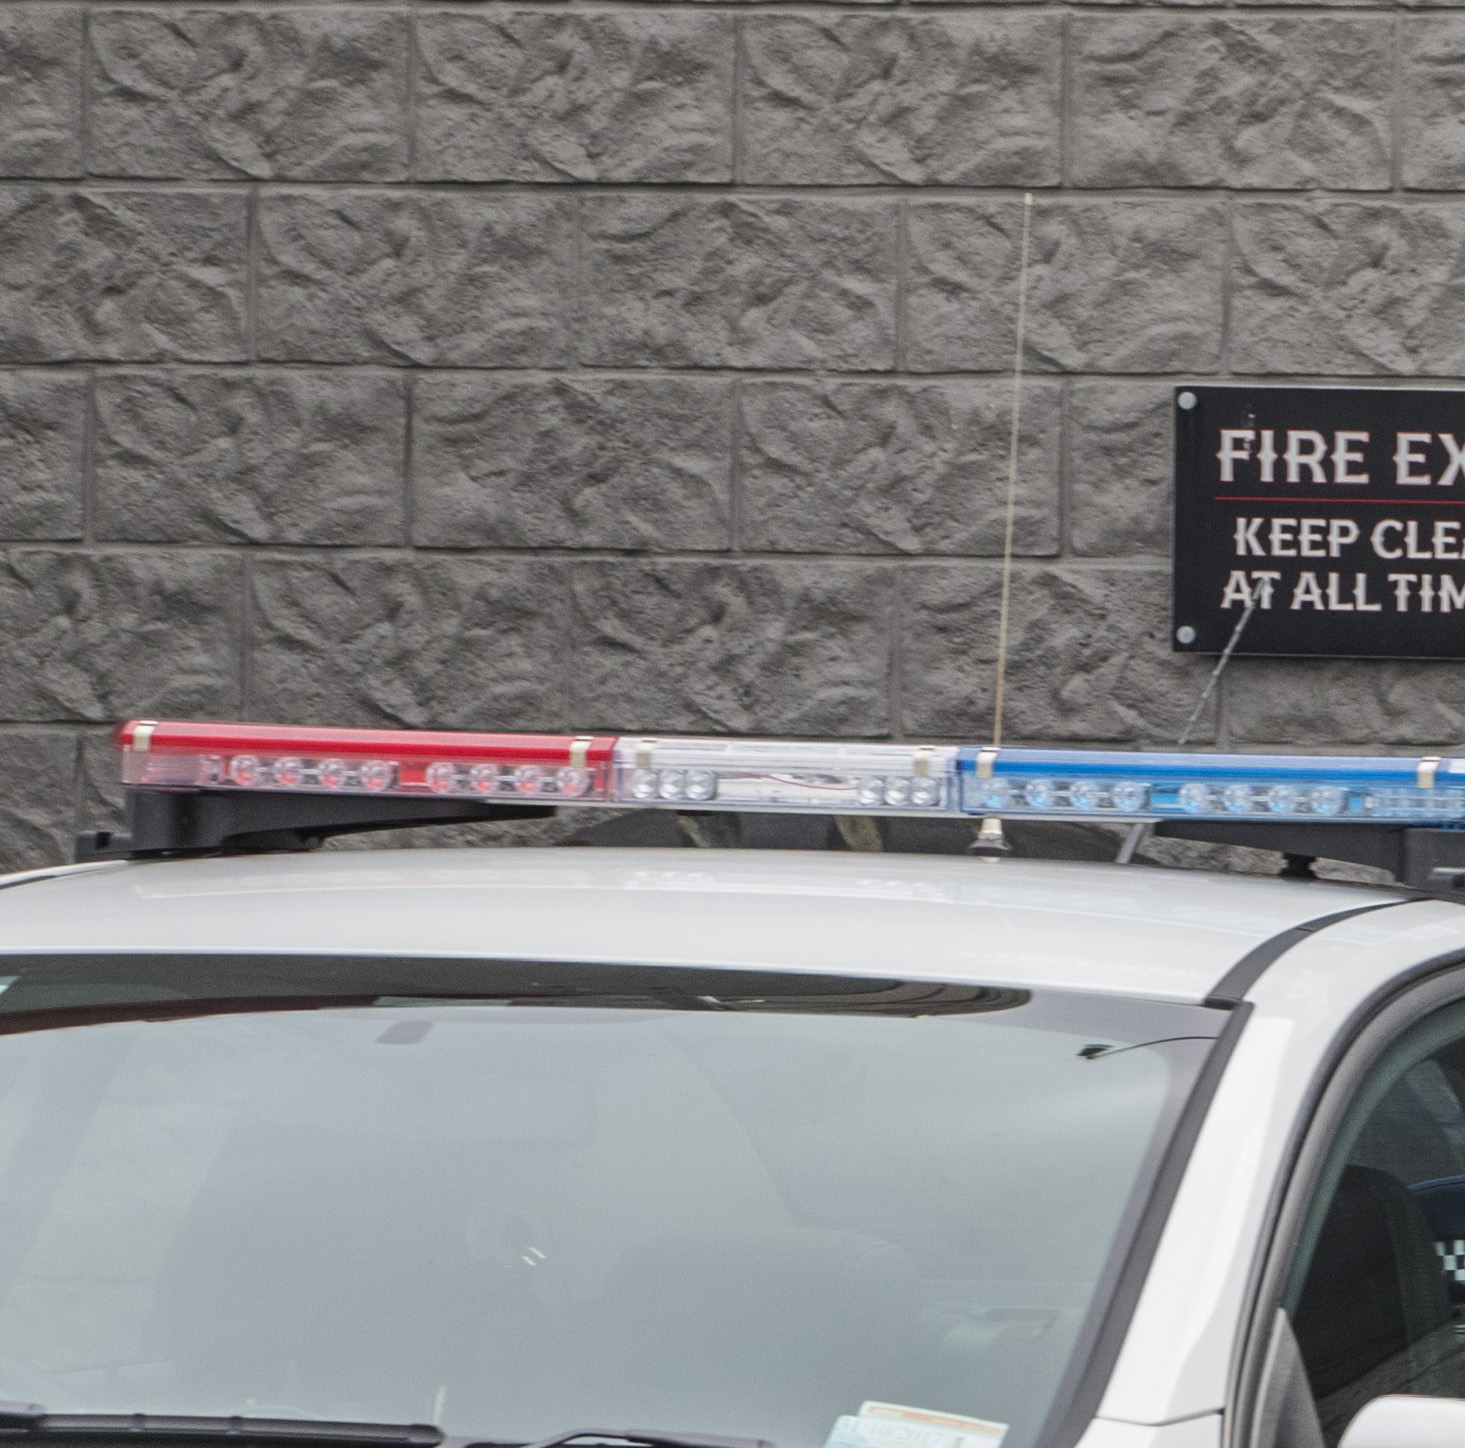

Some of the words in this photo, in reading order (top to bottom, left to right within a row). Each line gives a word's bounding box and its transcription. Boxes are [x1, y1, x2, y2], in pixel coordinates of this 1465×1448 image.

[1216, 428, 1371, 484] FIRE
[1233, 516, 1361, 558] KEEP
[1219, 570, 1282, 611] AT
[1290, 571, 1383, 612] ALL
